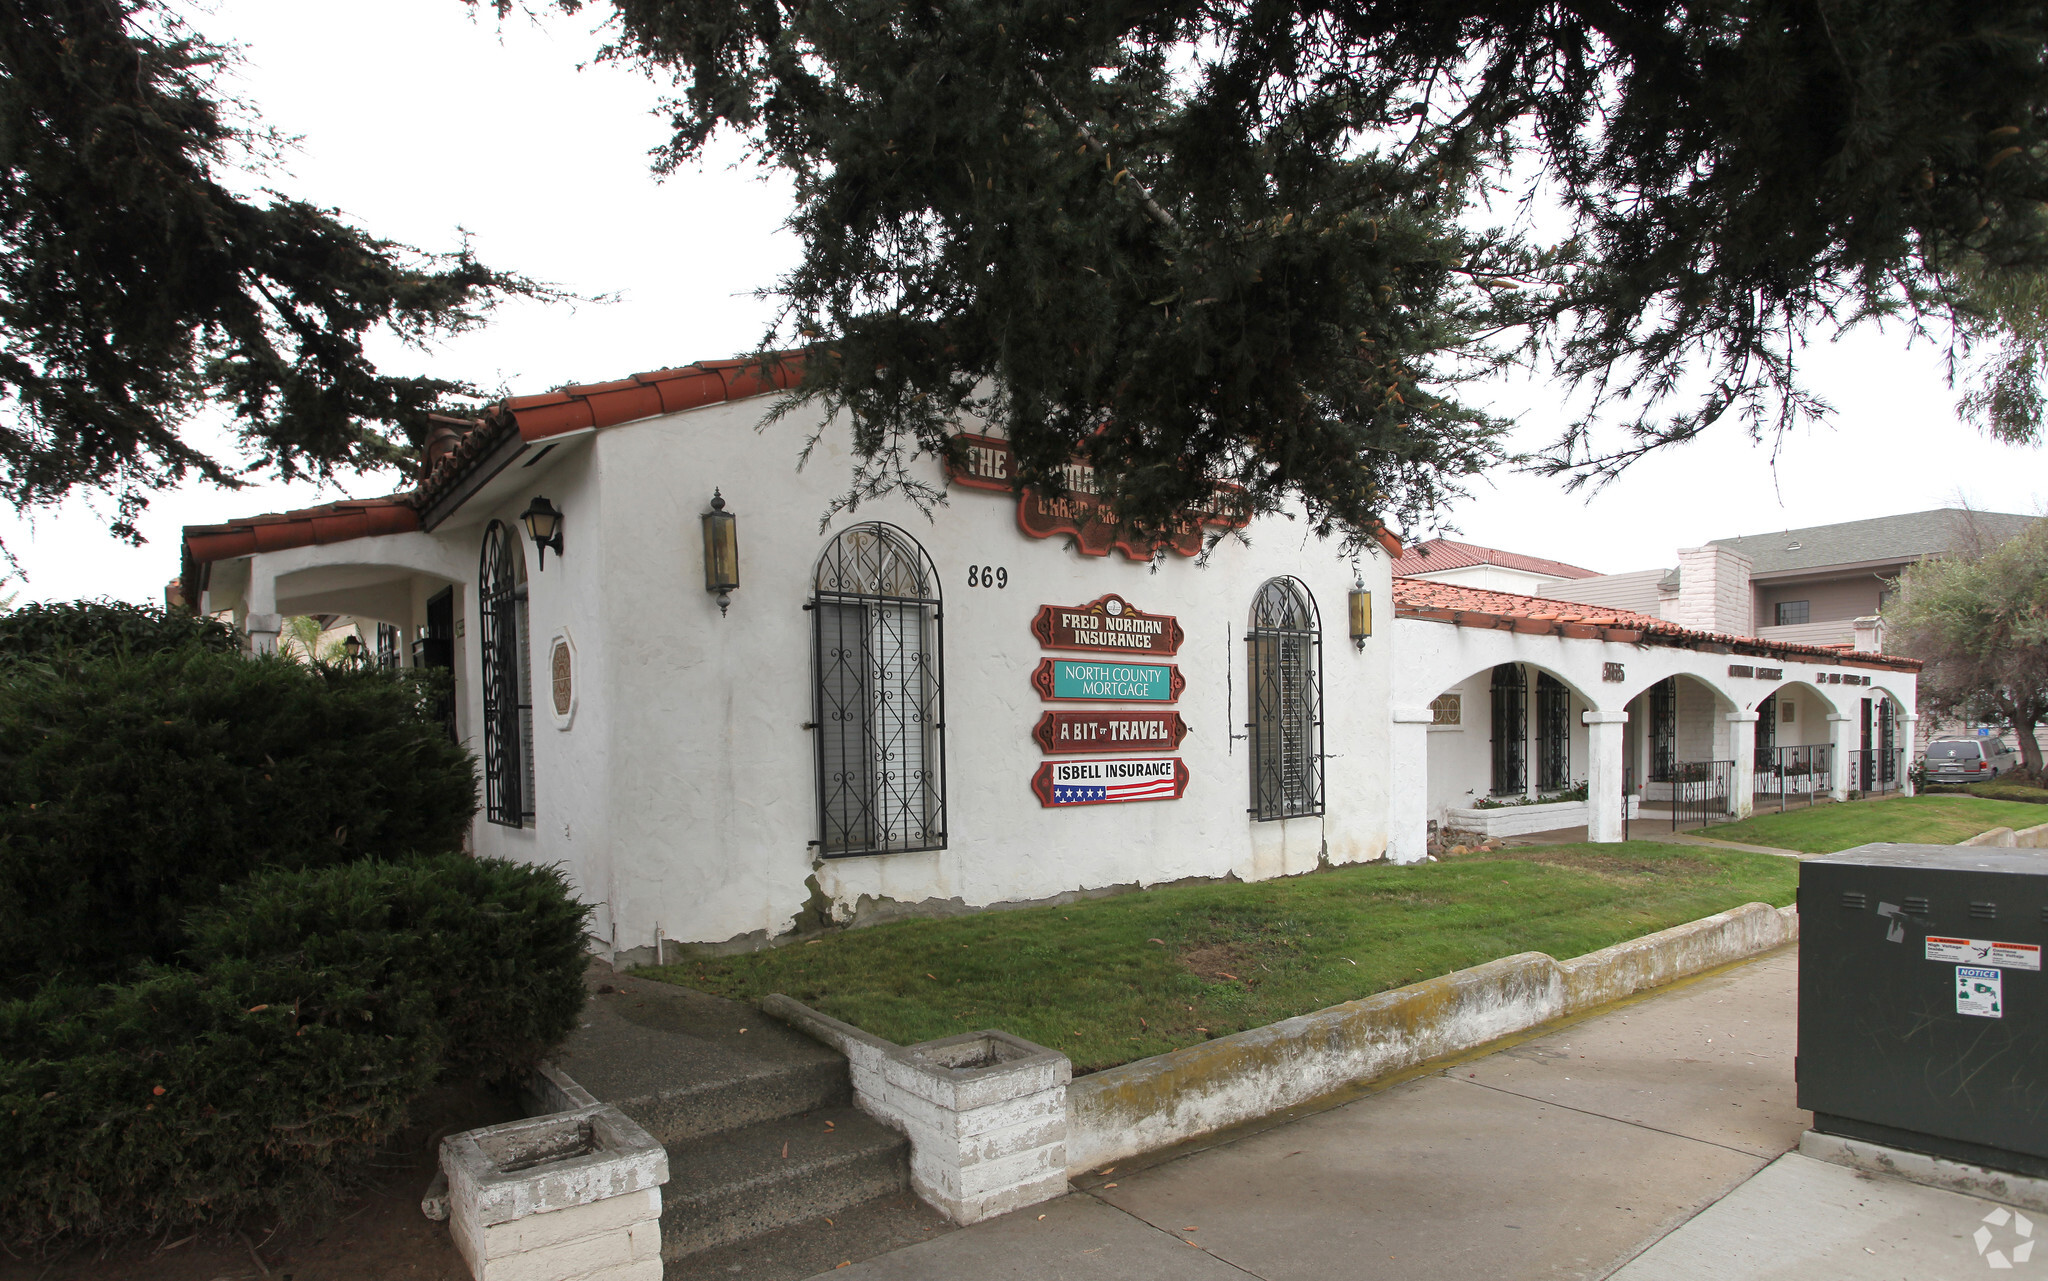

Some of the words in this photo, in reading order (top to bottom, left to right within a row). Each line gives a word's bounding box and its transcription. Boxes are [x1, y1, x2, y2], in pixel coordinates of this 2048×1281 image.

[966, 445, 1007, 480] THE
[967, 564, 1008, 589] 869
[1061, 613, 1099, 630] FRED
[1105, 617, 1162, 634] NORMAN
[1074, 630, 1152, 649] INSURANCE
[1065, 665, 1110, 681] NORTH
[1112, 667, 1161, 683] COUNTY
[1082, 681, 1149, 697] MORTGAGE
[1060, 723, 1069, 740] A
[1073, 722, 1098, 740] BIT
[1109, 720, 1168, 741] TRAVEL
[1058, 764, 1101, 780] ISBELL
[1105, 762, 1171, 778] INSURANCE
[1960, 969, 1996, 978] NOTICE
